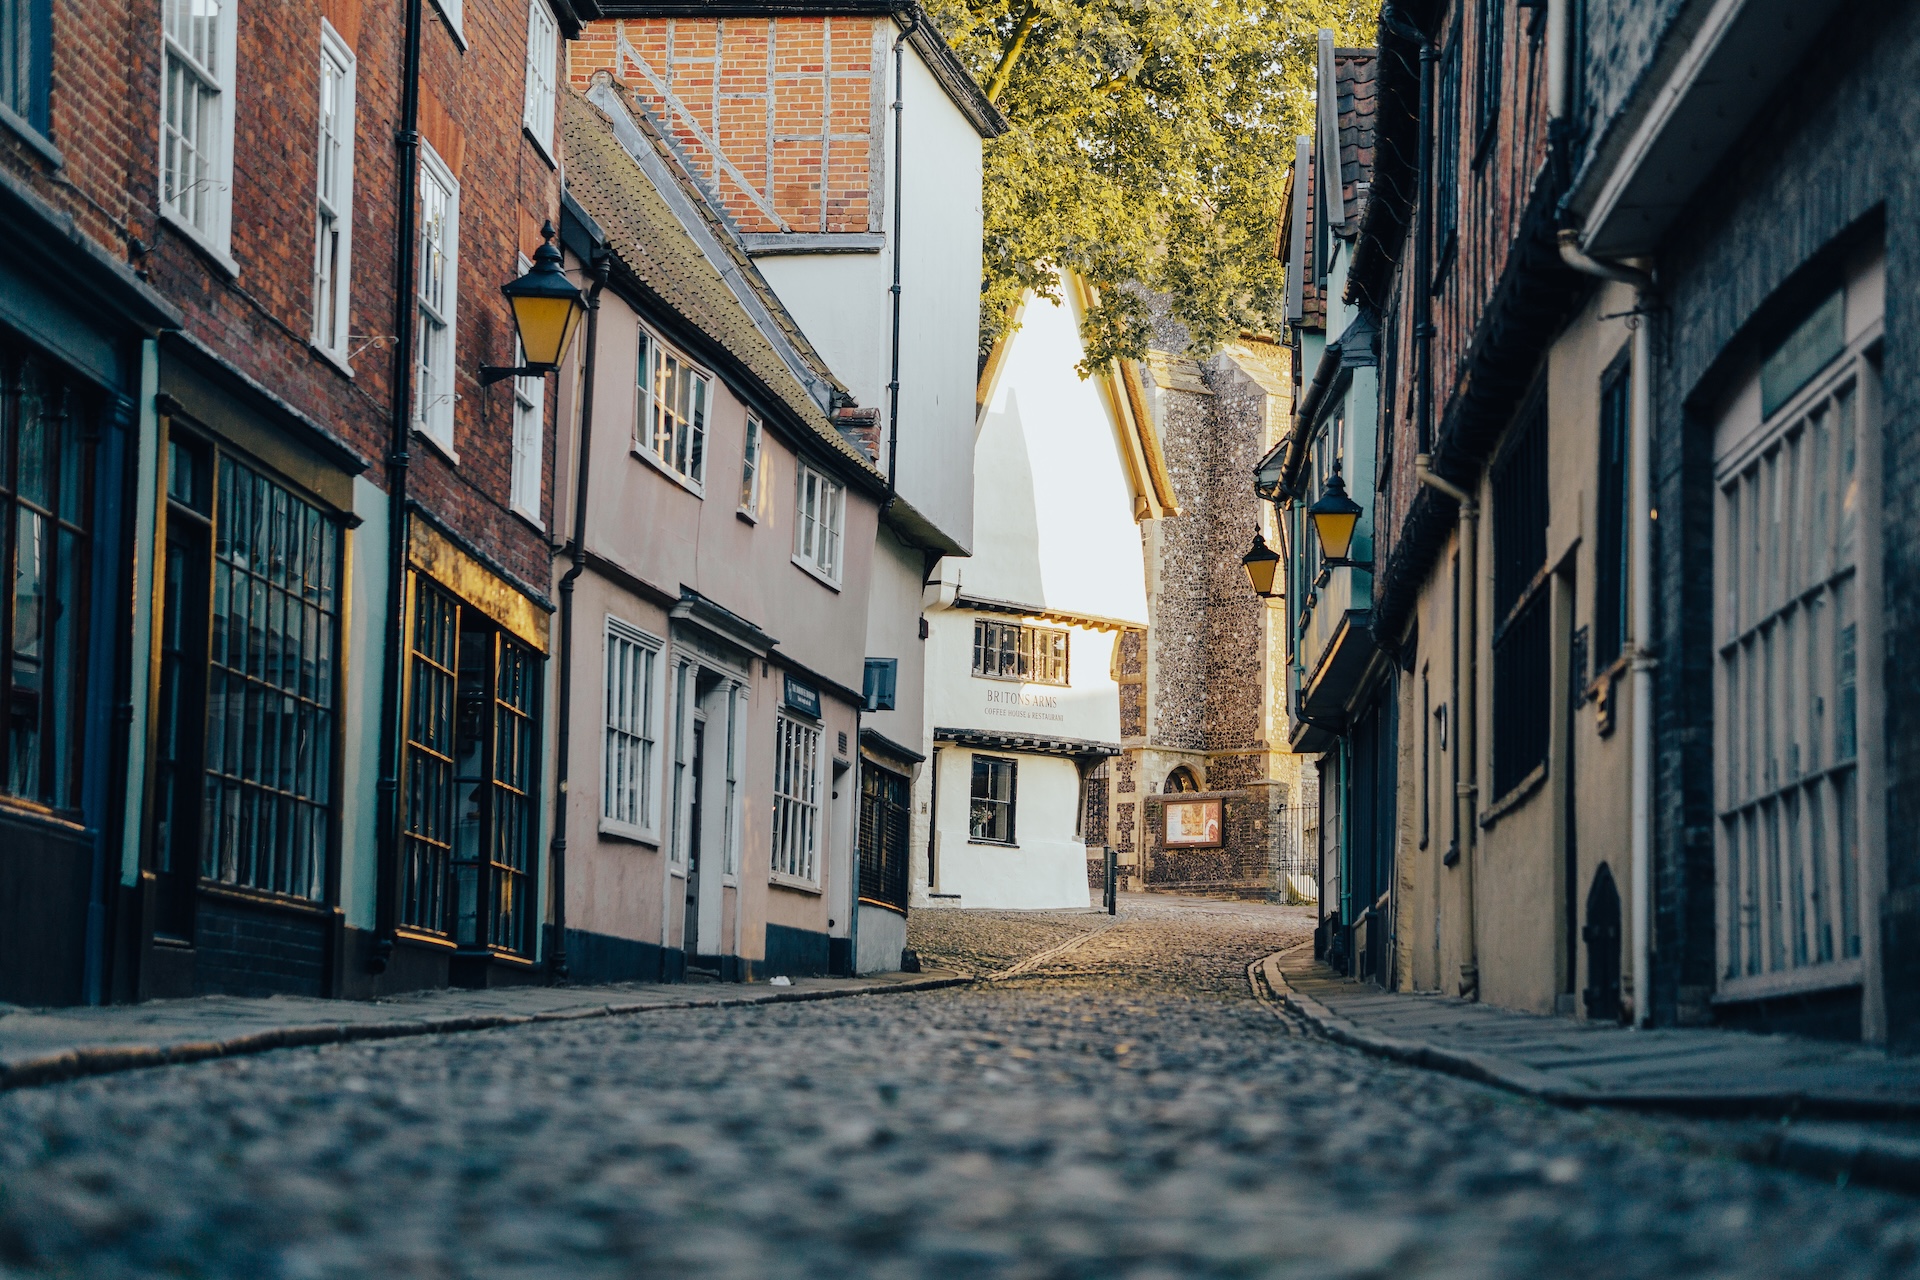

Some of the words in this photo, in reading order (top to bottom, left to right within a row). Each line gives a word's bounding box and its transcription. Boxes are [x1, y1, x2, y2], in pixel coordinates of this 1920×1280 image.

[987, 689, 1030, 706] BRITONS
[1032, 694, 1057, 709] ARMS
[984, 707, 1006, 716] COFFEE
[1008, 709, 1026, 718] HOUSE
[1031, 711, 1064, 722] RESTAURANT
